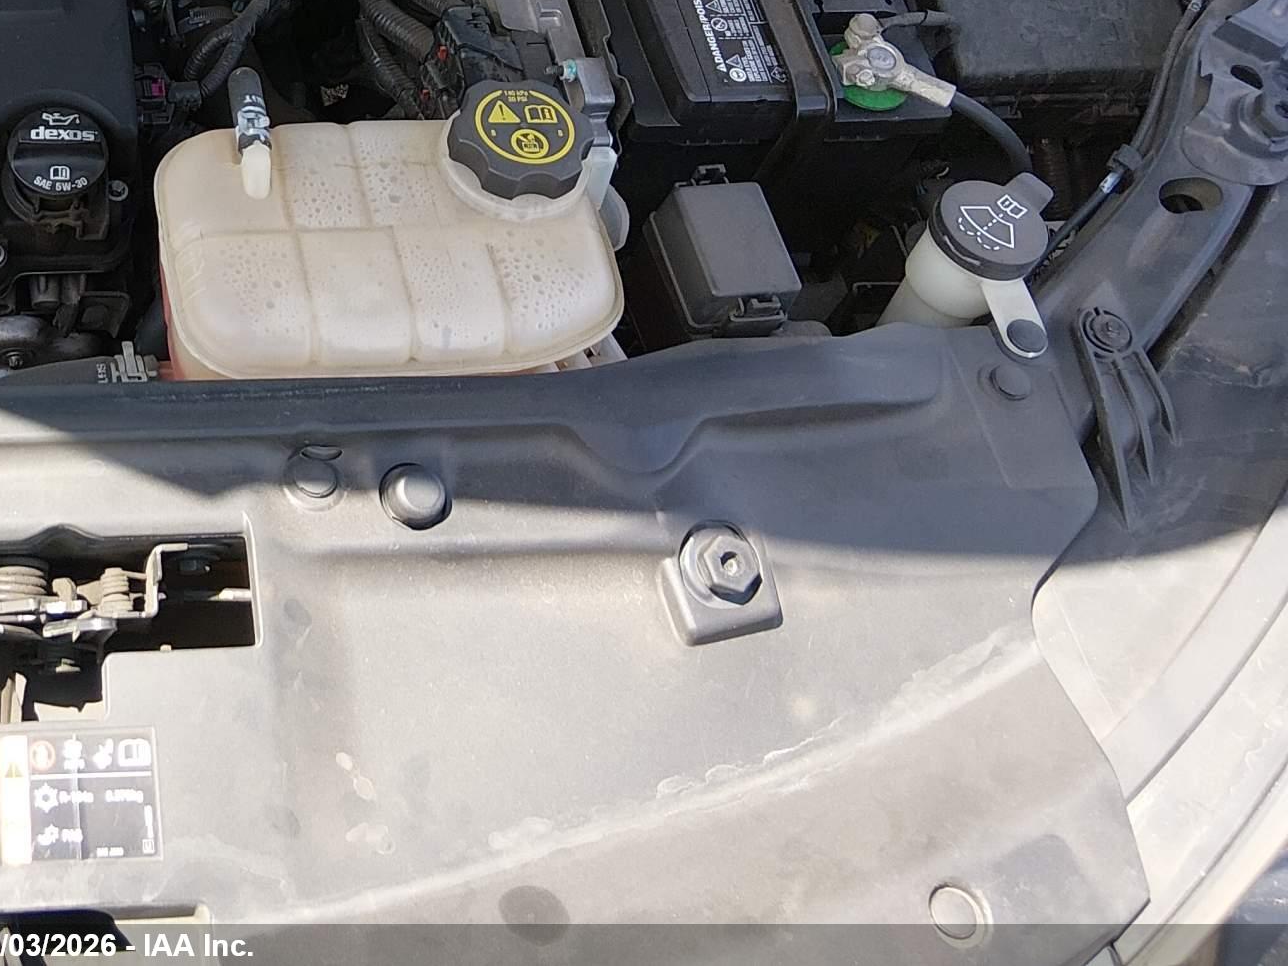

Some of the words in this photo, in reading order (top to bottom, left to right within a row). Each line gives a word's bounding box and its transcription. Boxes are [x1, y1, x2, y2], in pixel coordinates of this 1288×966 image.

[30, 126, 96, 141] dexos
[33, 176, 53, 190] SAE
[55, 177, 88, 192] 5W-30
